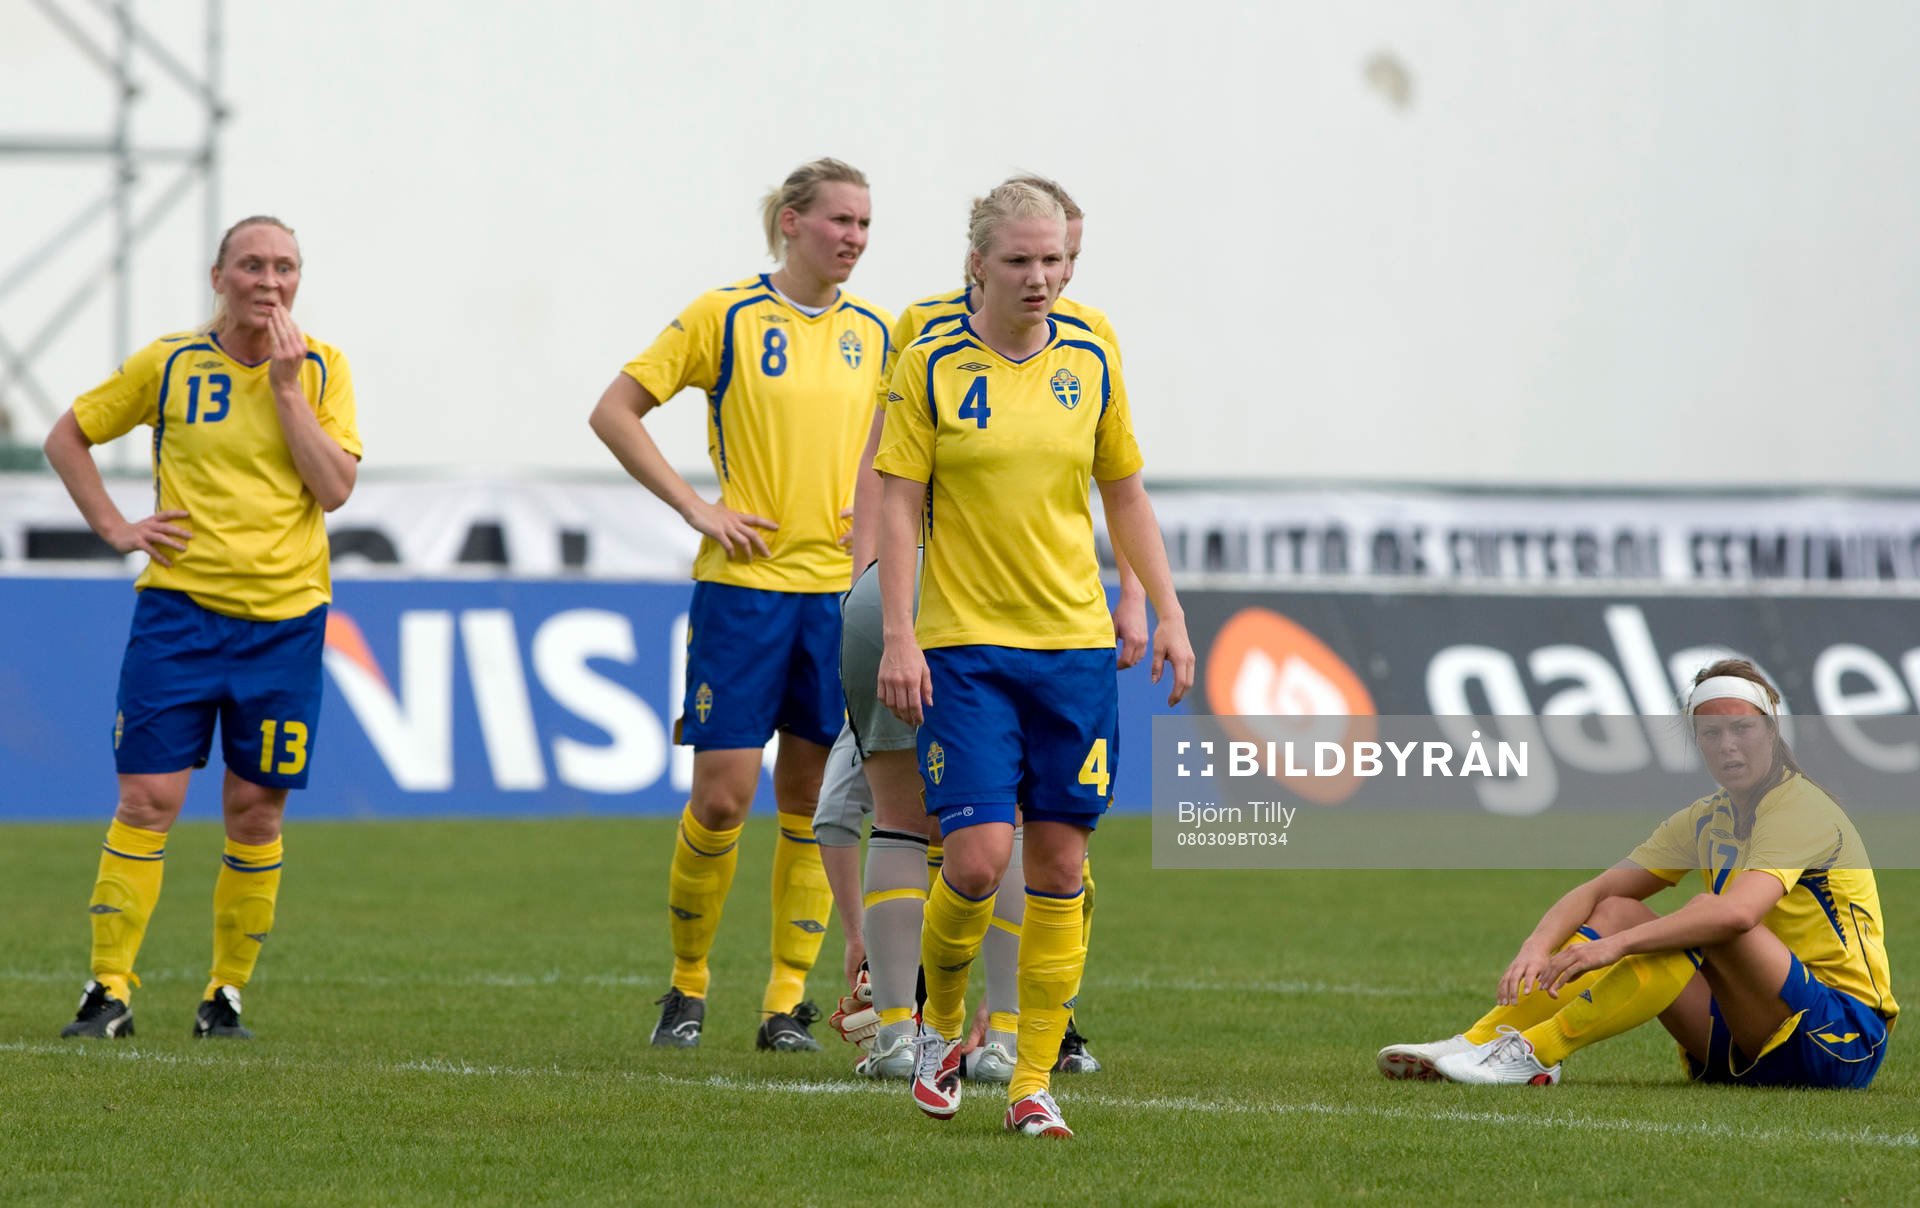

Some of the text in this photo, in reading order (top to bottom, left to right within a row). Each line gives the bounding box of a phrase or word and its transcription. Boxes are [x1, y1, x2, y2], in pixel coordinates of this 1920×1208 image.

[761, 327, 787, 377] 8
[186, 373, 232, 425] 13
[958, 375, 991, 429] 4
[260, 719, 308, 775] 13
[1077, 738, 1110, 797] 4
